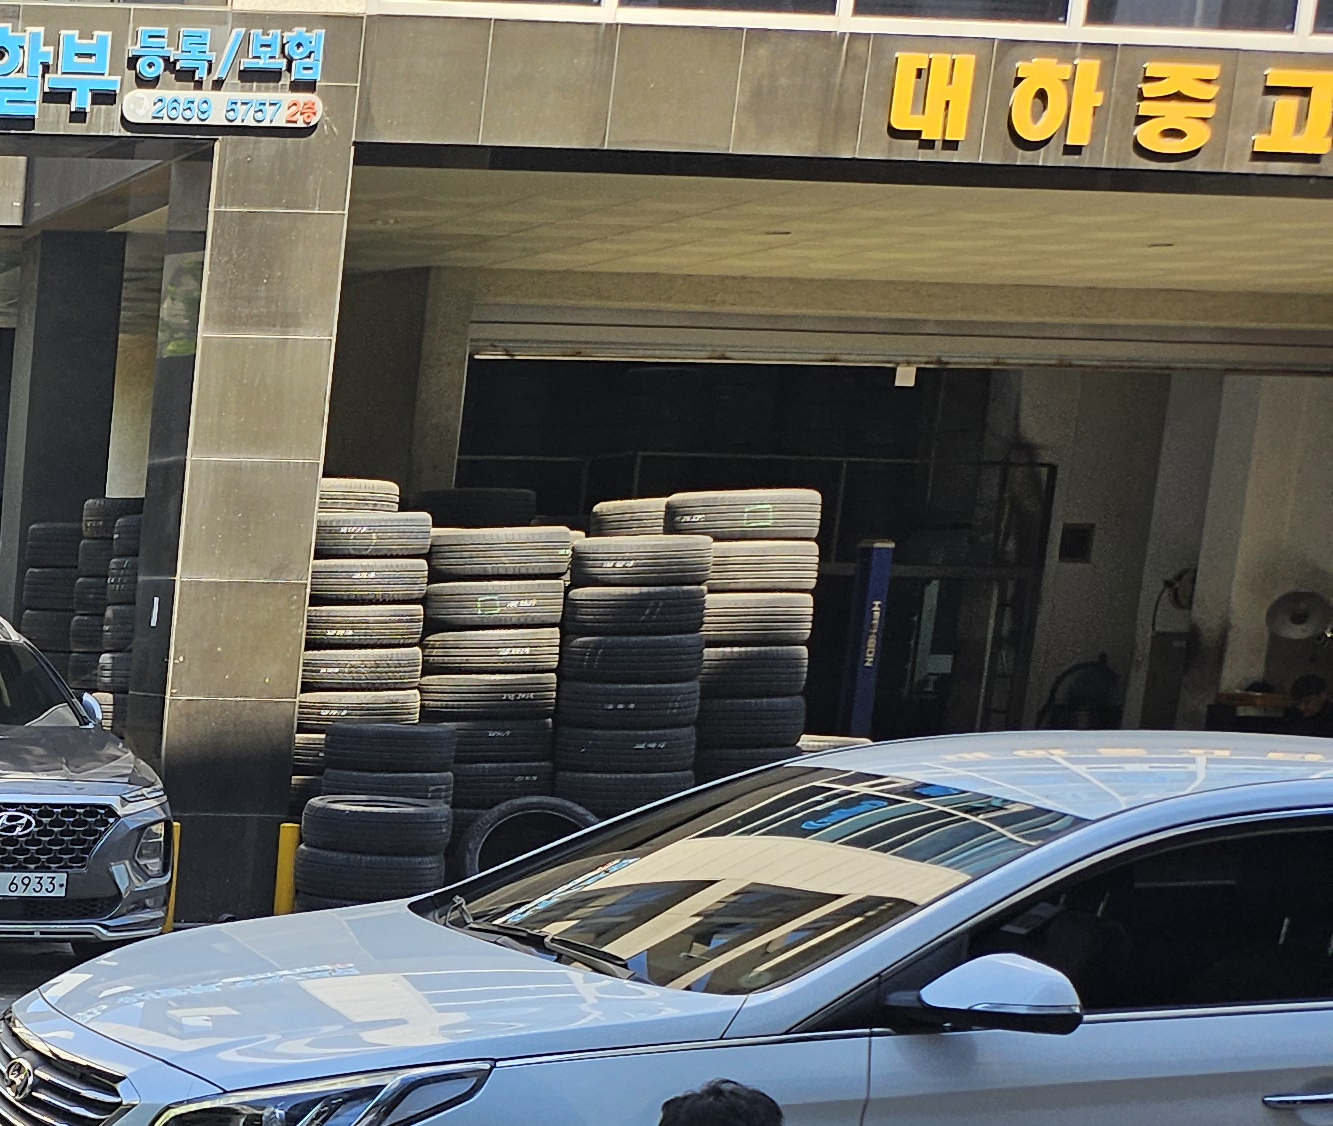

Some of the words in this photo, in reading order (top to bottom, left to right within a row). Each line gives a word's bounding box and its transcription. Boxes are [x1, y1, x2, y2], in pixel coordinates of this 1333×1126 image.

[128, 27, 326, 81] 등록/보험
[151, 95, 213, 121] 2659
[224, 97, 283, 124] 5757
[286, 99, 318, 125] 2층
[889, 51, 1333, 156] 대하중고
[8, 875, 57, 894] 6933
